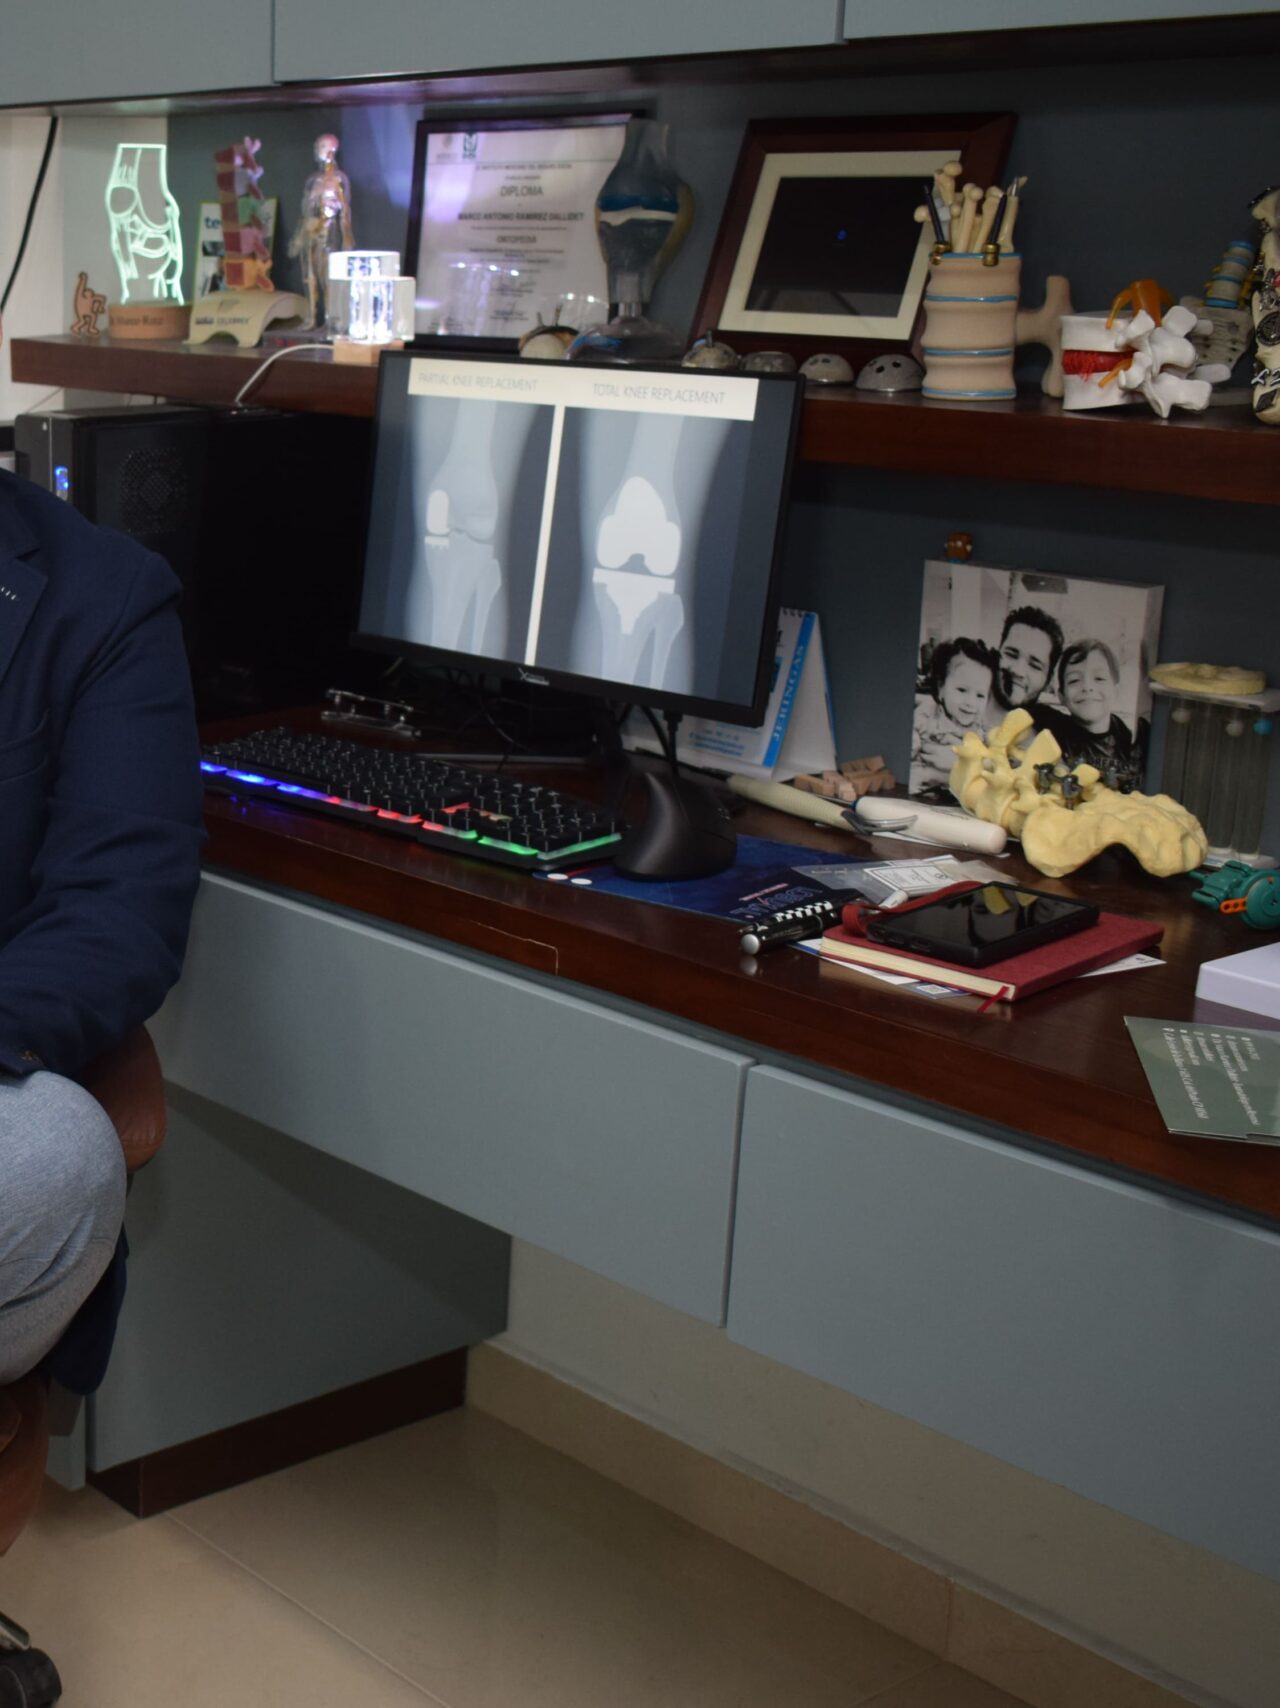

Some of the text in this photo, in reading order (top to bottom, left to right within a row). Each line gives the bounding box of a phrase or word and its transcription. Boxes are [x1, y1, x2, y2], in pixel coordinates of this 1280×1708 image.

[500, 185, 544, 198] DIPLOMA
[418, 372, 538, 391] PARTIAL KNEE REPLACEMENT
[594, 383, 725, 404] TOTAL KNEE REPLACEMENT
